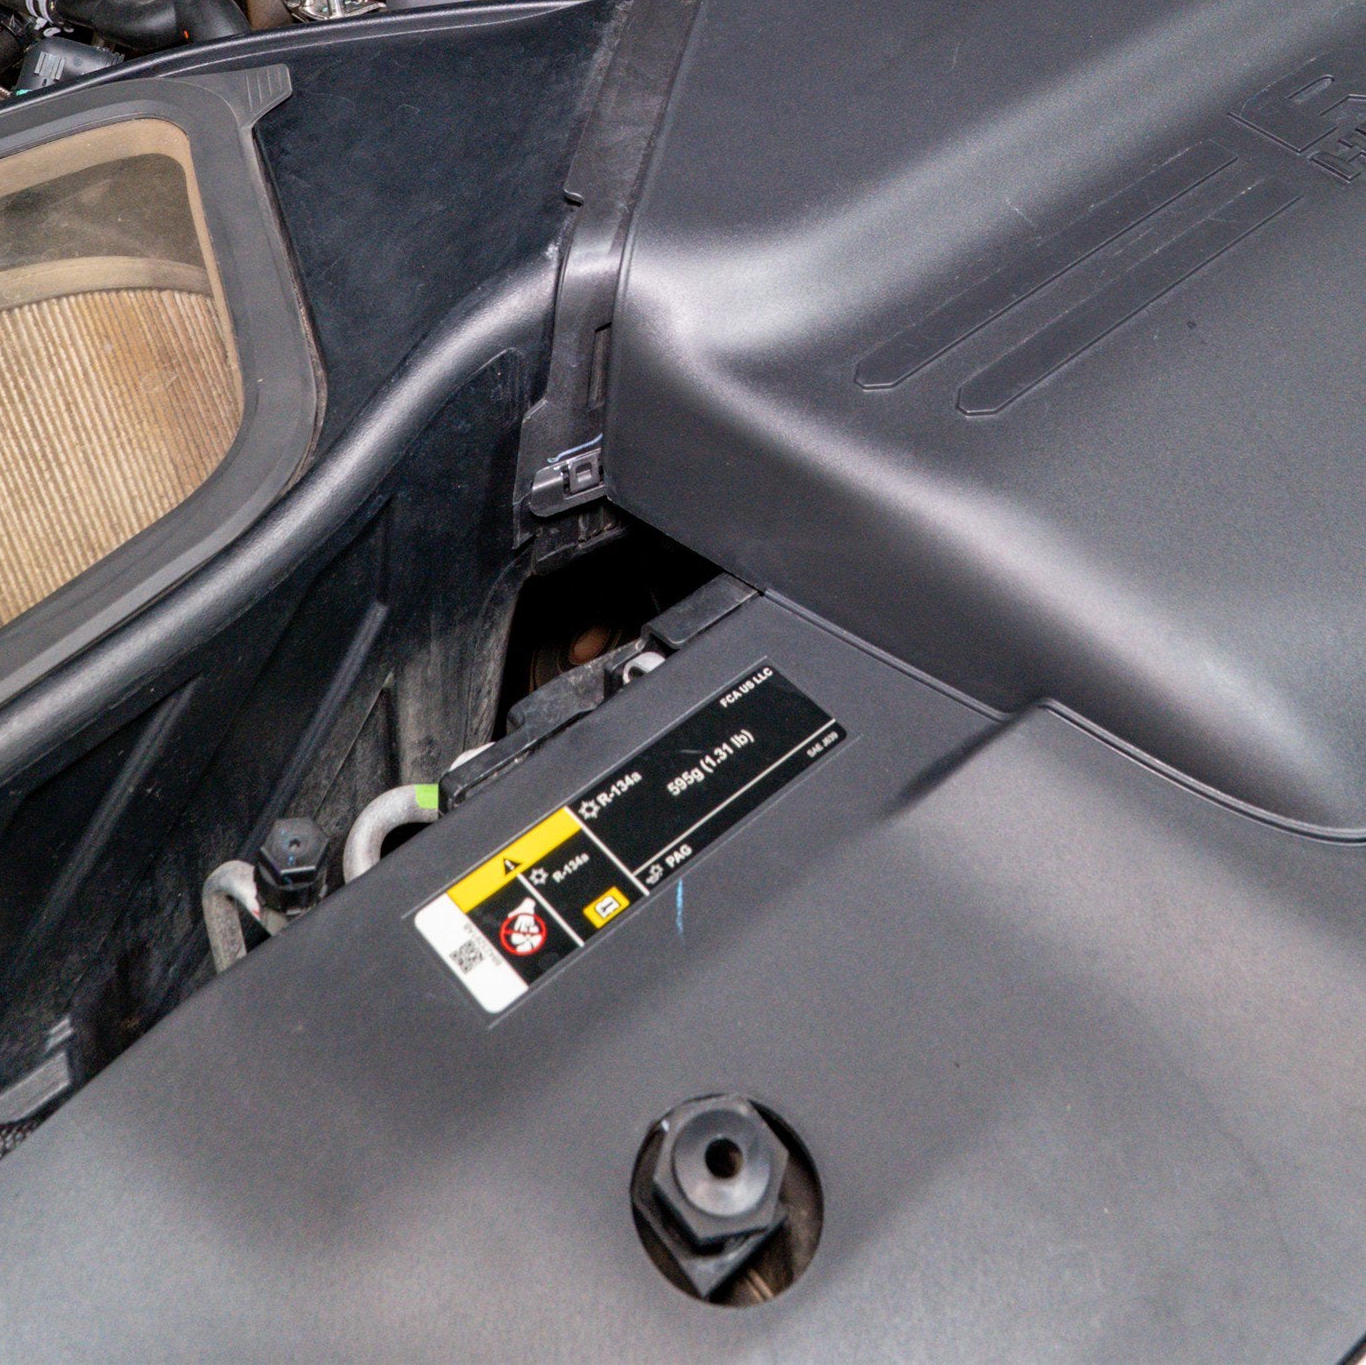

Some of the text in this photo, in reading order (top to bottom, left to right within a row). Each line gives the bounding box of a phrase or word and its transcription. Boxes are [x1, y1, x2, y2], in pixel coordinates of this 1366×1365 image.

[720, 666, 773, 708] FCA US LLC
[668, 728, 754, 798] 595g (1.31 lb)
[807, 742, 823, 757] SAE
[597, 769, 642, 807] R-134a
[553, 852, 588, 882] R-134a
[665, 843, 693, 868] PAG
